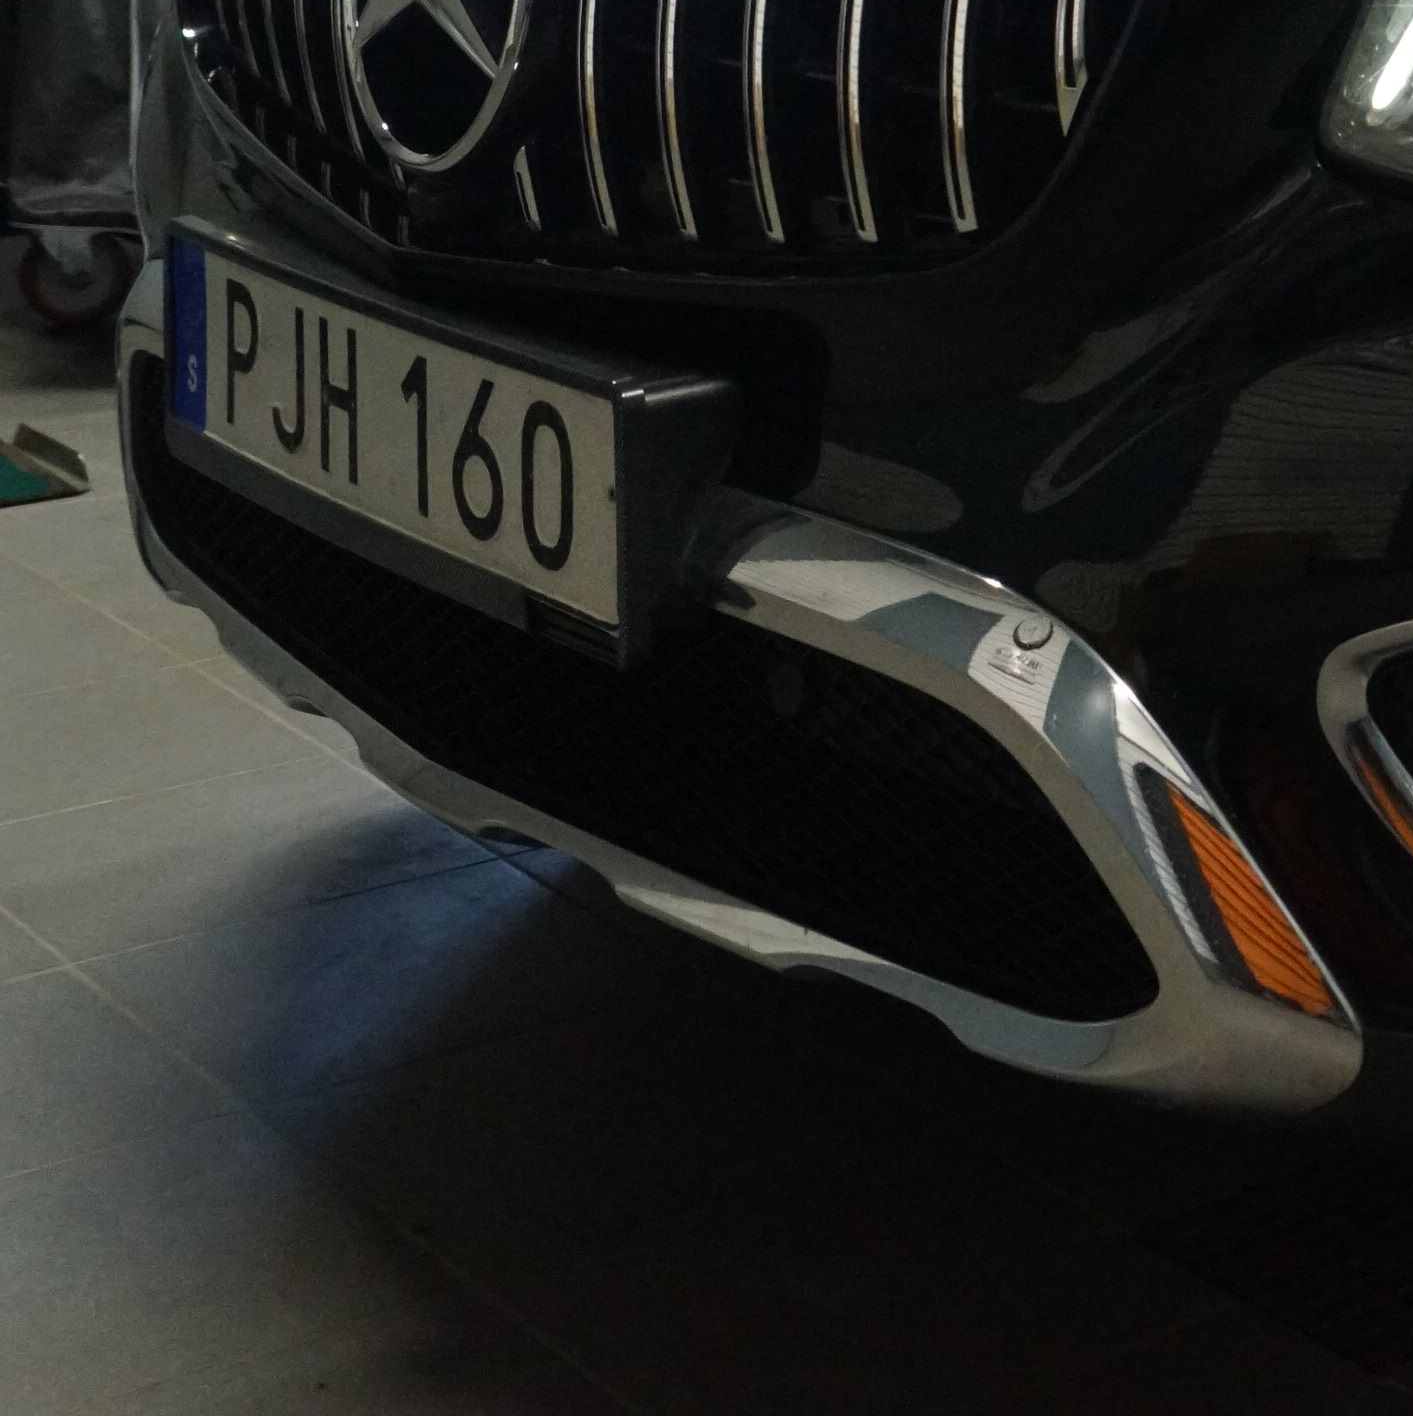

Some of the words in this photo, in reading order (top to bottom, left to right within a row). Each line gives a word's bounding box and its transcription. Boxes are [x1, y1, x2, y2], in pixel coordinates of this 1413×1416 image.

[187, 354, 199, 392] S
[226, 278, 358, 485] PJH
[401, 355, 575, 572] 160
